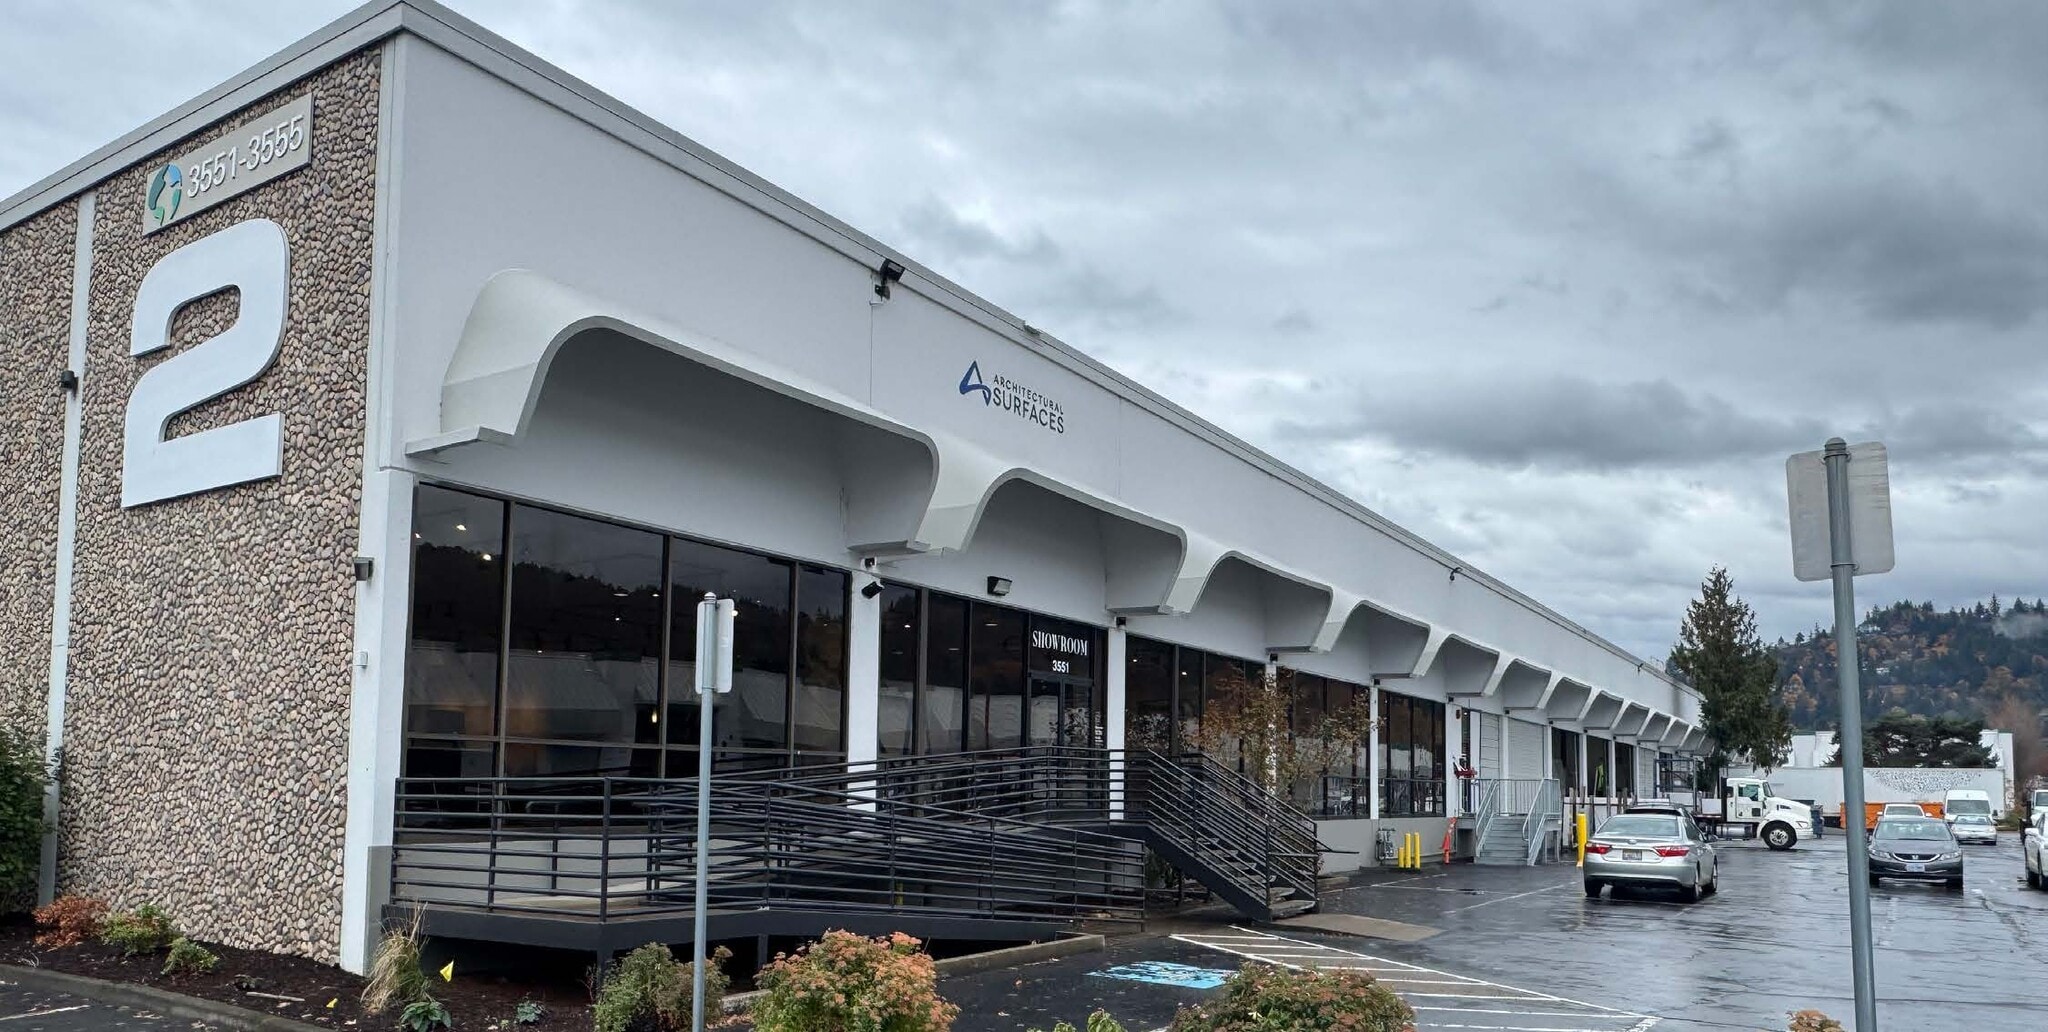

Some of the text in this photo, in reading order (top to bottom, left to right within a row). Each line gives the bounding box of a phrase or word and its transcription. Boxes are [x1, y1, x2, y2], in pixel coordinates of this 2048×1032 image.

[187, 114, 304, 198] 3551-3555
[121, 218, 290, 508] 2
[992, 387, 1064, 434] SURFACES
[993, 374, 1064, 415] ARCHITECTURAL
[1032, 630, 1088, 656] SHOWROOM
[1052, 660, 1069, 673] 3551
